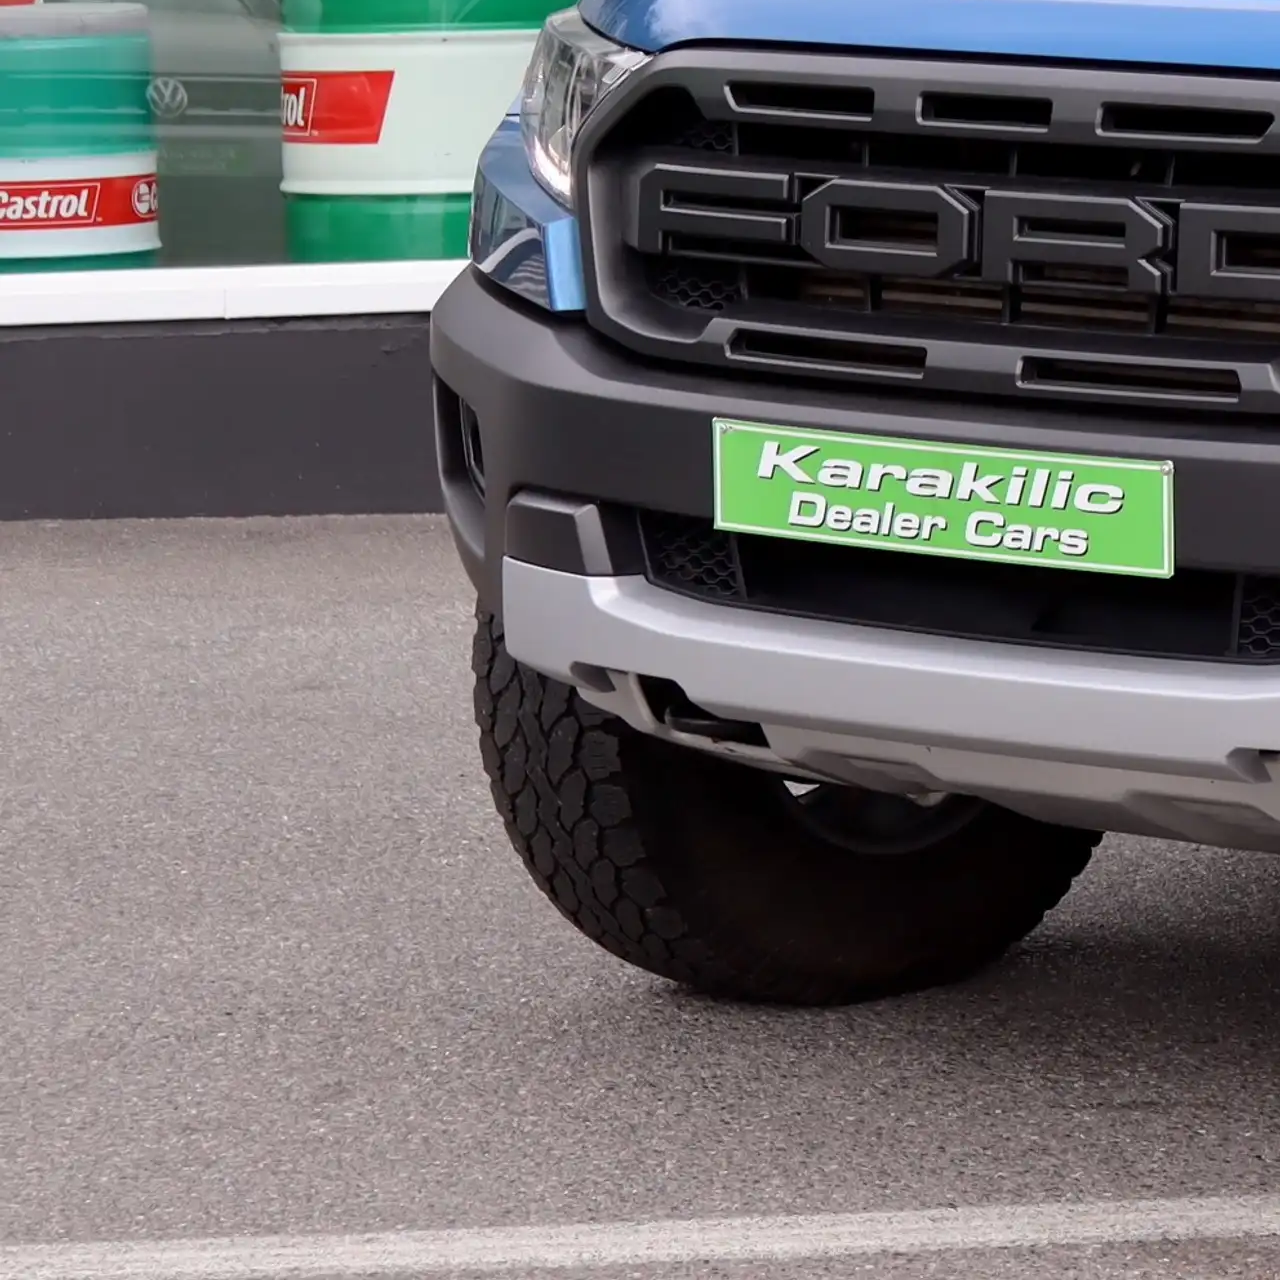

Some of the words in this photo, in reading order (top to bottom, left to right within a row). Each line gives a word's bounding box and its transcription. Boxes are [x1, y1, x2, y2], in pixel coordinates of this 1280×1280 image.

[757, 441, 1125, 514] Karakilic
[788, 491, 947, 540] Dealer
[965, 511, 1089, 556] Cars
